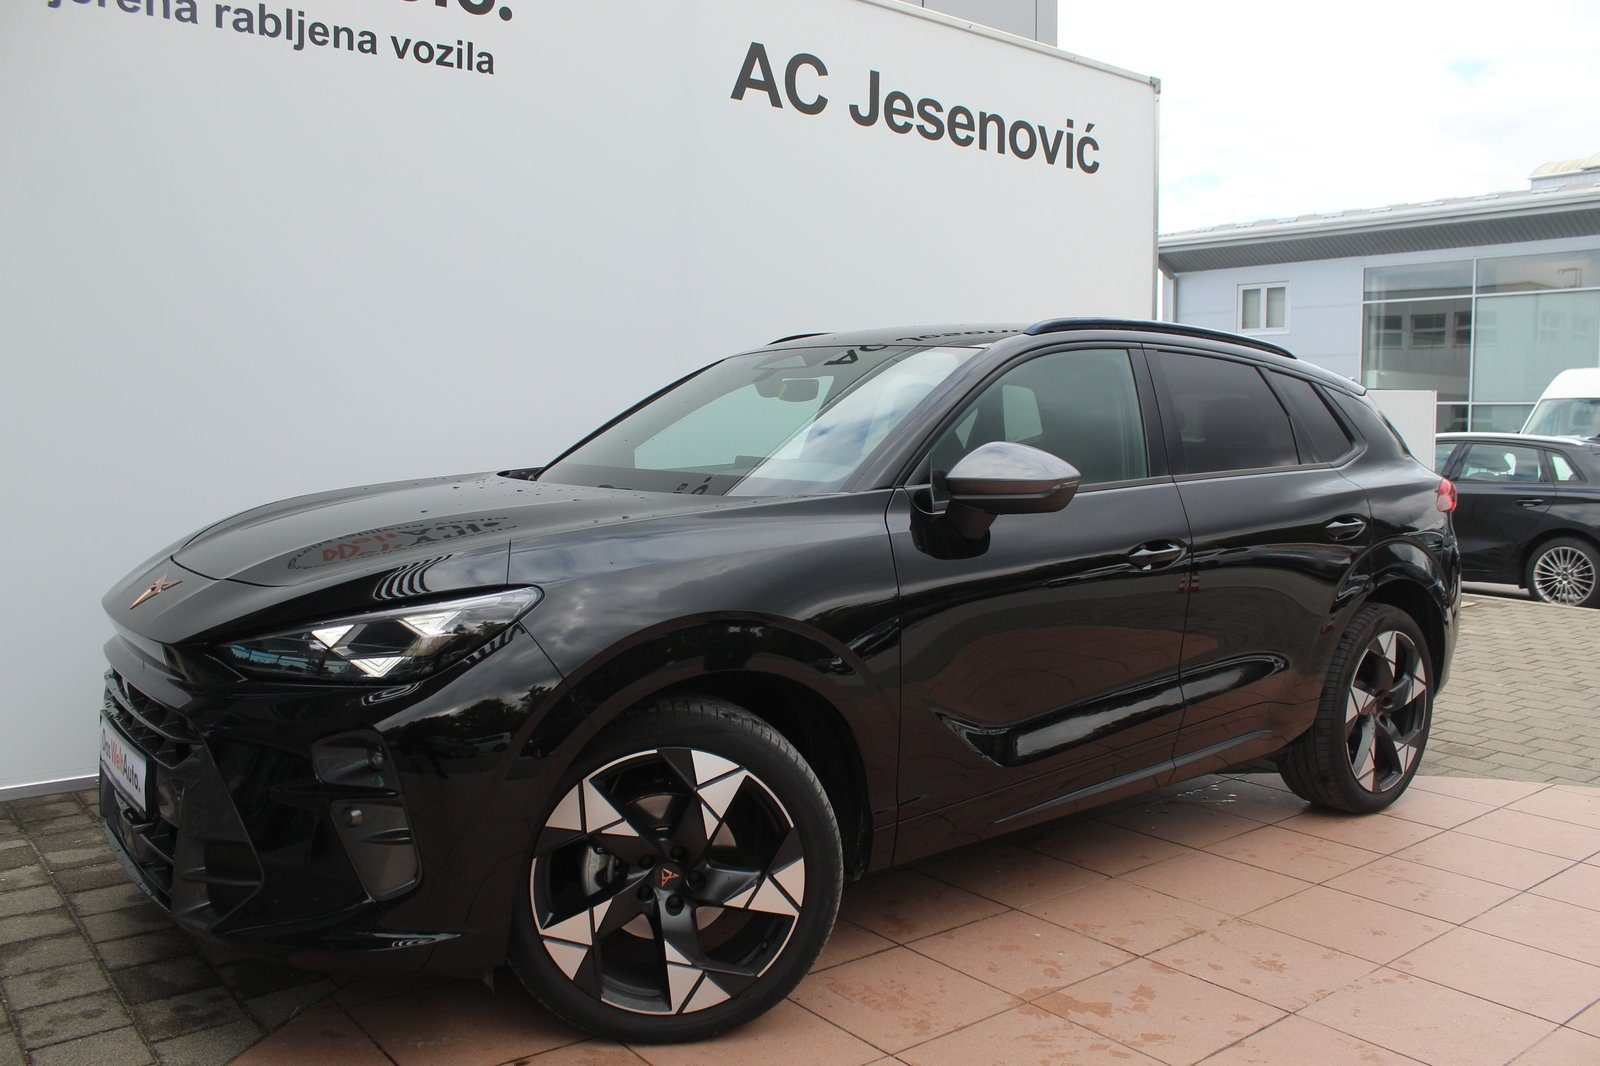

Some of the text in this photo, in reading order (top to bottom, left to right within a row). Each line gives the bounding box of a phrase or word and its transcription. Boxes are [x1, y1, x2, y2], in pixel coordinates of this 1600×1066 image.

[214, 2, 378, 55] rabljena
[390, 35, 495, 75] vozila
[730, 41, 1100, 175] AC Jesenović
